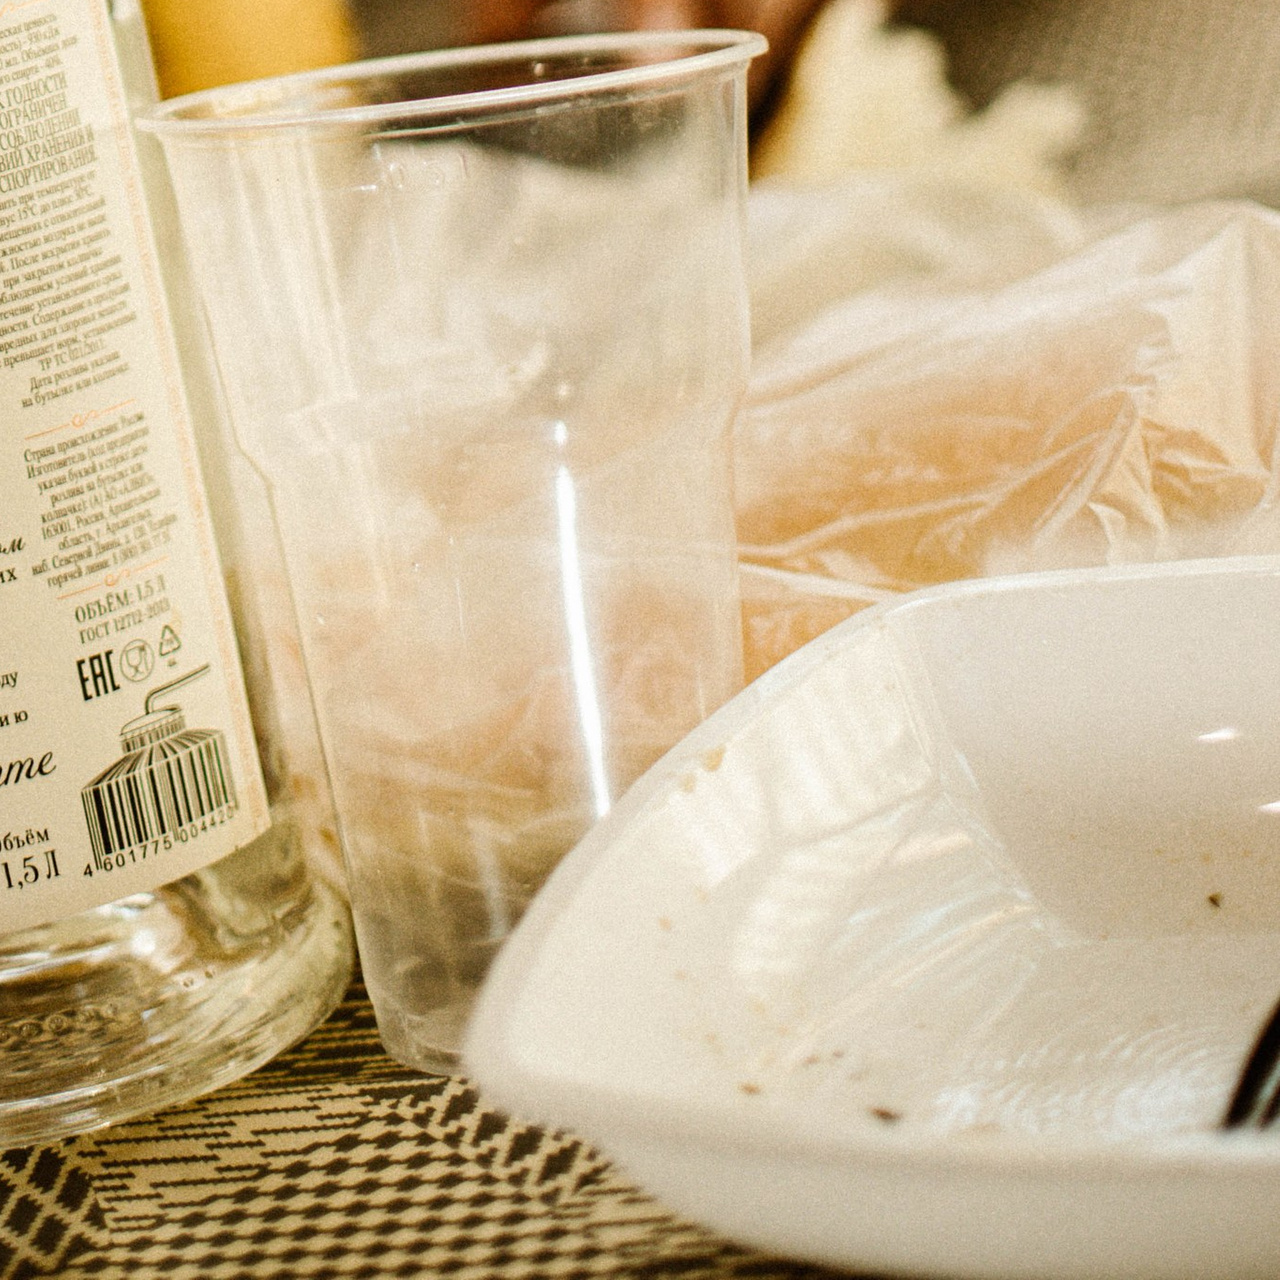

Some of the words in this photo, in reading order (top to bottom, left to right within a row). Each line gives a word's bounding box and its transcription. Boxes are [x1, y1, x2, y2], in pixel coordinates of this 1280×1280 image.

[0, 92, 67, 130] ОГРАНИЧЕН
[79, 621, 109, 644] ГОСТ
[83, 862, 94, 878] 4
[103, 834, 173, 873] 601775
[179, 807, 236, 844] 004420
[0, 854, 40, 890] 1,5
[46, 849, 61, 880] Л
